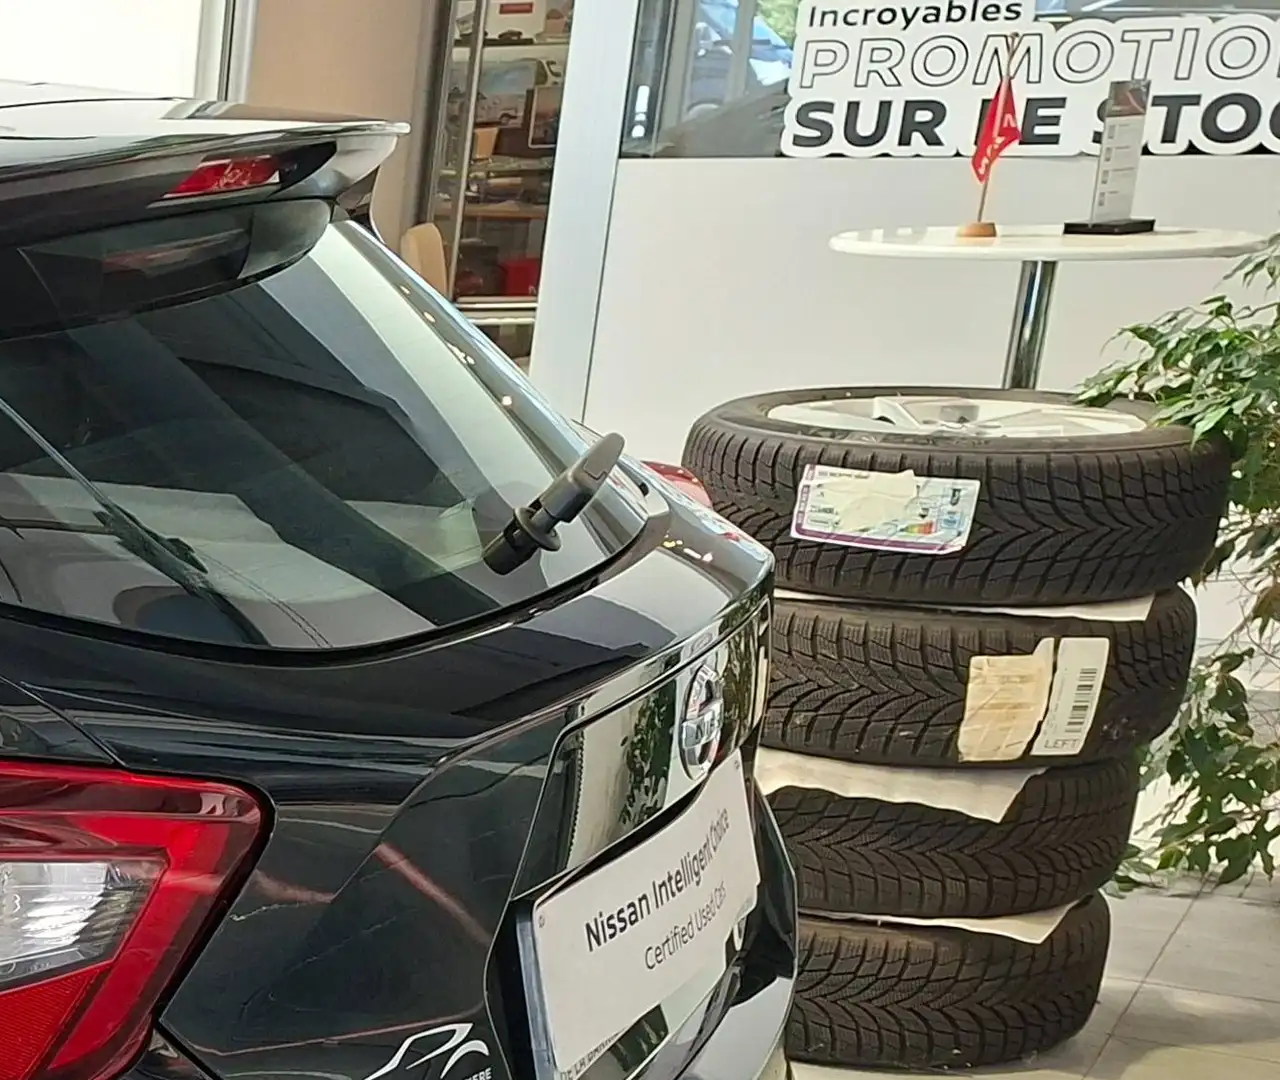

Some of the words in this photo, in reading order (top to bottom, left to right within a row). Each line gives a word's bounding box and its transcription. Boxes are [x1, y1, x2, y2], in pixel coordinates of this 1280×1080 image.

[809, 2, 1023, 31] Incroyables
[799, 25, 1280, 89] PROMOTIO
[792, 99, 947, 147] SUR
[585, 893, 651, 952] Nissan
[652, 832, 712, 910] Intelligent
[709, 808, 730, 853] Choice
[645, 914, 694, 970] Certified
[696, 896, 716, 932] Used
